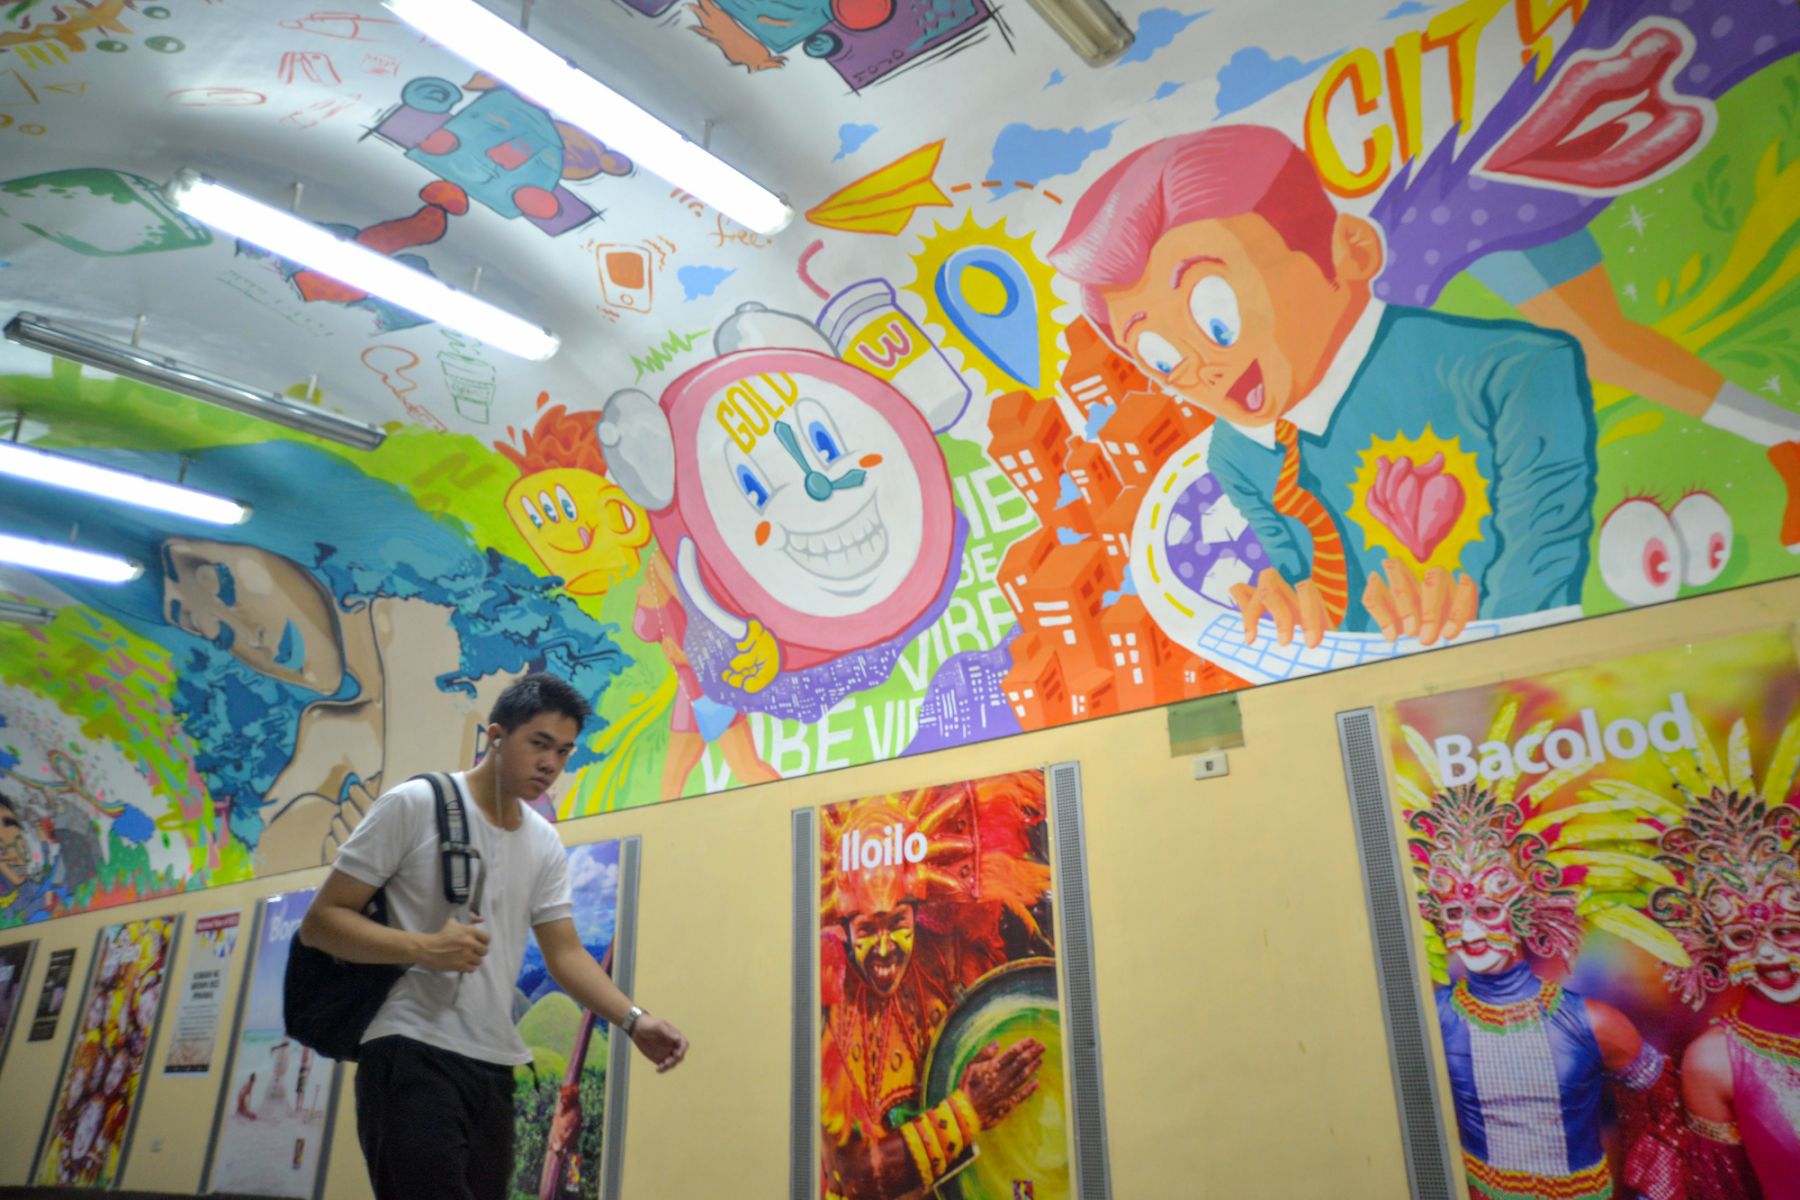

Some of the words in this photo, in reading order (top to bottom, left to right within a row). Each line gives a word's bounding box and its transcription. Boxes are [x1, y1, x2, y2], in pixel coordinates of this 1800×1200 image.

[716, 371, 799, 455] GOLD
[1435, 691, 1697, 788] Bacolod
[842, 823, 928, 872] Iloilo
